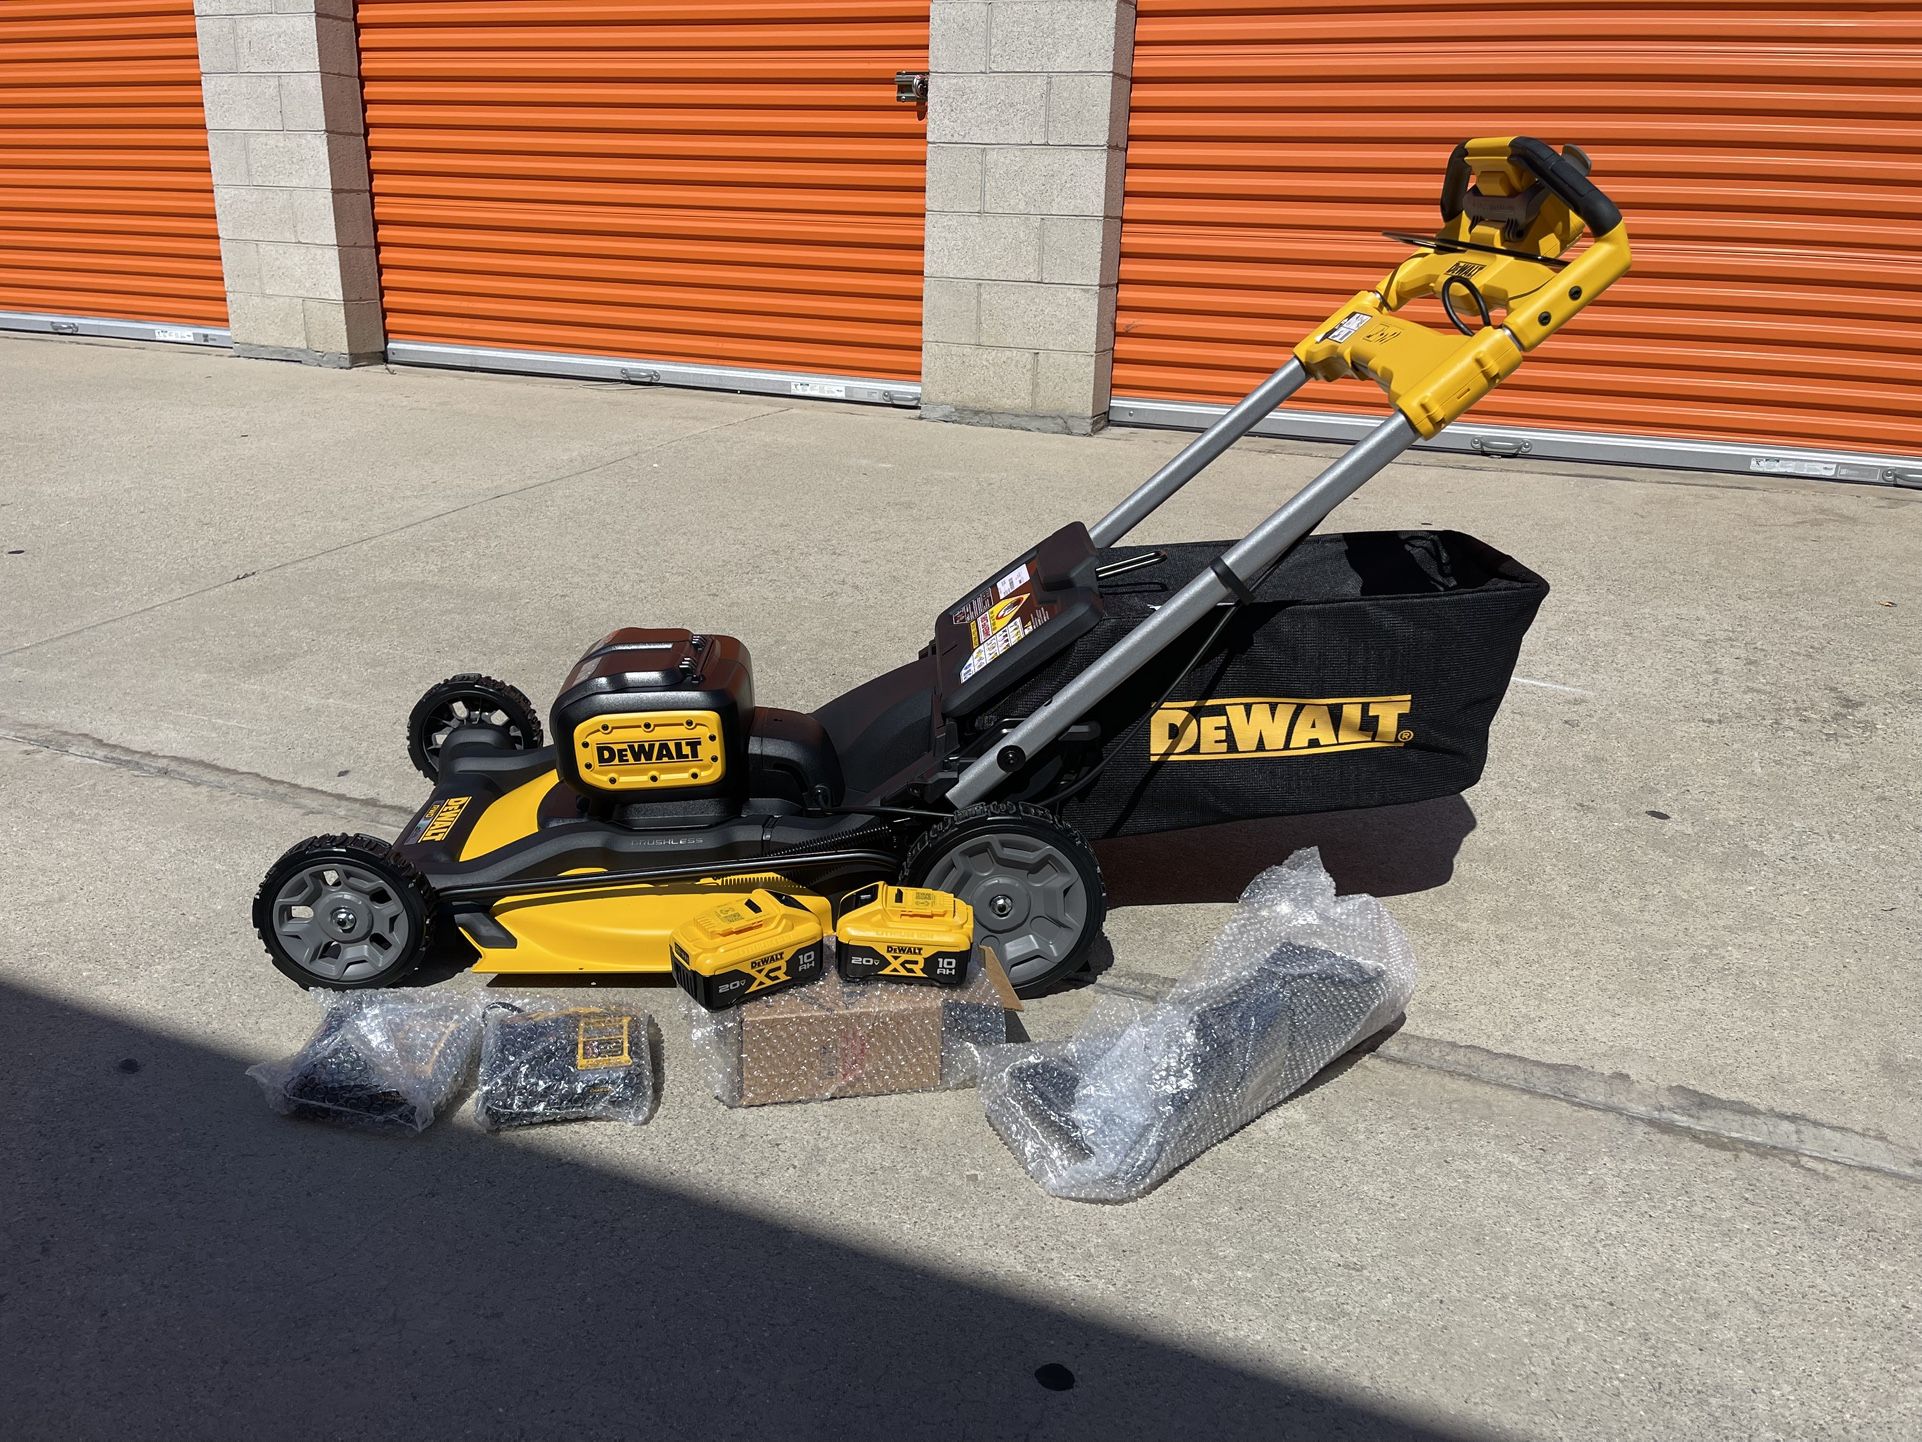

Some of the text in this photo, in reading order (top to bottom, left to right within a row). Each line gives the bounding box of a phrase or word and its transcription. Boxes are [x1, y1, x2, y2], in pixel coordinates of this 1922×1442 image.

[596, 741, 702, 764] DEWALT
[421, 796, 470, 842] DEWALT
[631, 837, 704, 846] BRUSHLESS
[798, 951, 815, 964] 10
[886, 945, 923, 955] DEWALT
[750, 951, 785, 969] DEWALT
[877, 954, 929, 977] XR
[937, 958, 956, 969] 10
[744, 960, 793, 994] XR
